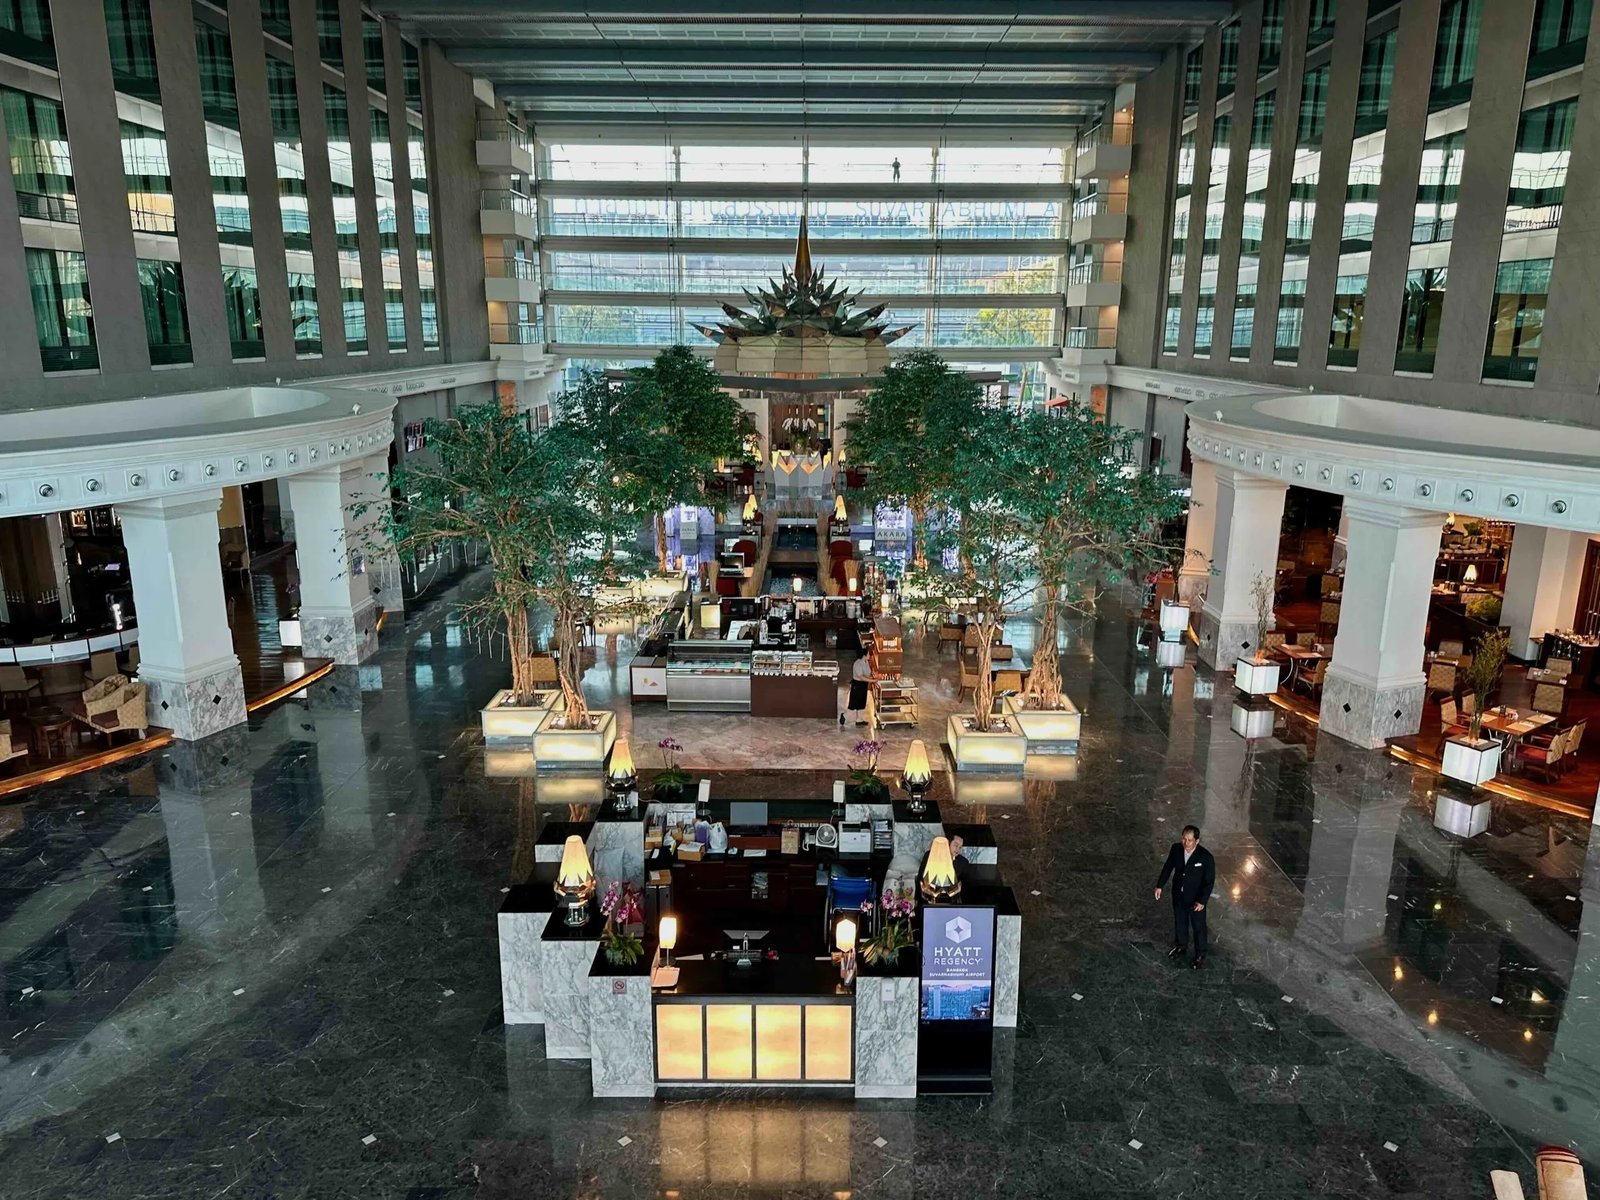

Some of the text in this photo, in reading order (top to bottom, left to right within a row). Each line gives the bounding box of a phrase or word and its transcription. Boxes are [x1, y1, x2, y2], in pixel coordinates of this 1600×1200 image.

[856, 201, 1026, 218] SUVARABHUMI
[934, 947, 982, 957] HYATT
[934, 957, 982, 965] REGENCY
